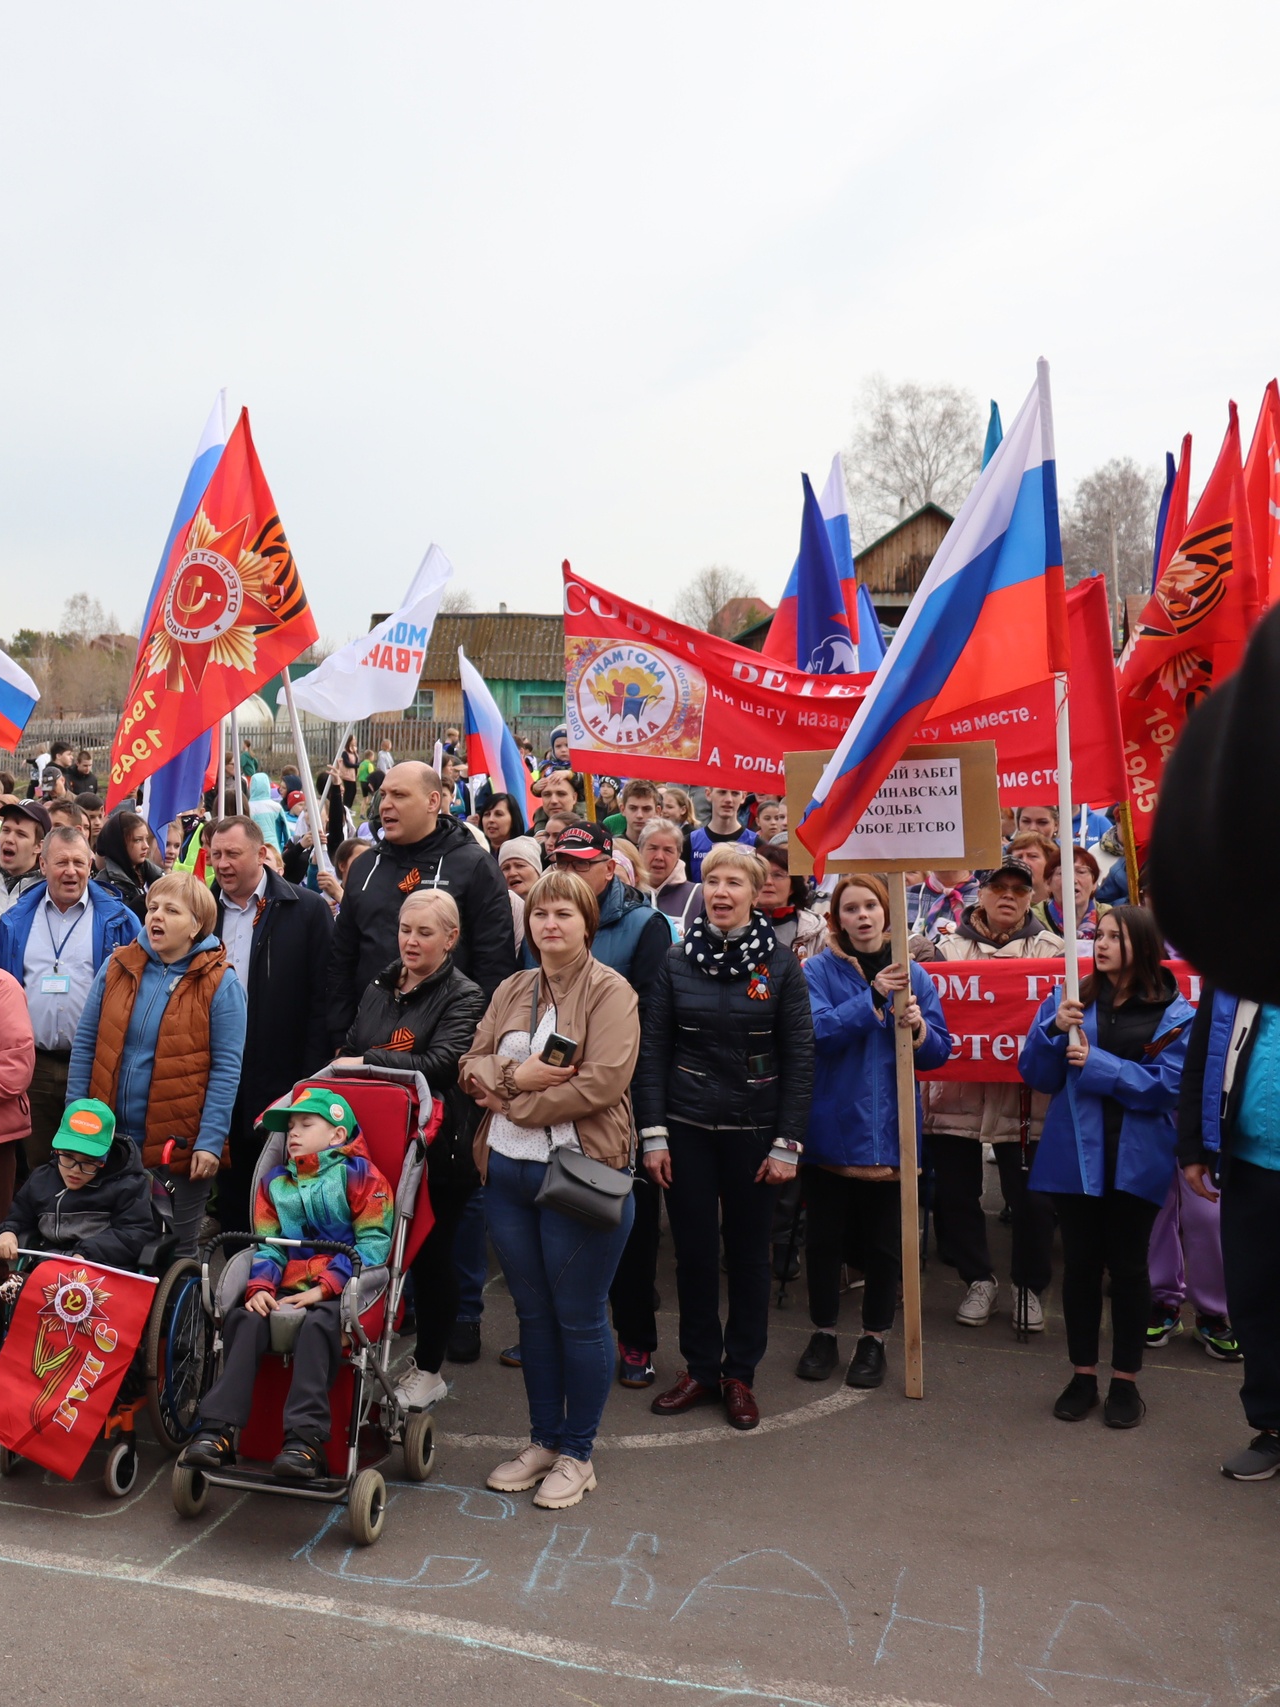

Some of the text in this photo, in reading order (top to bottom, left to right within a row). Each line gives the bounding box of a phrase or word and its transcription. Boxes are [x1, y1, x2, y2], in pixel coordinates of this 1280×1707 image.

[592, 650, 623, 676] НАМ
[731, 661, 872, 698] ВЕТЕ
[711, 685, 734, 706] Ни
[740, 699, 787, 725] шагу
[588, 715, 660, 743] НЕ БЕДА
[1145, 707, 1176, 762] 194
[707, 746, 721, 768] А
[734, 754, 785, 775] тольк
[912, 765, 958, 780] ЗАБЕГ
[1124, 740, 1159, 813] 1945
[874, 784, 958, 799] ИНАВСКАЯ
[865, 804, 922, 817] ХОДЬБА
[852, 821, 956, 836] ОБОЕ ДЕТСВО
[52, 1322, 119, 1433] 9 МАЯ
